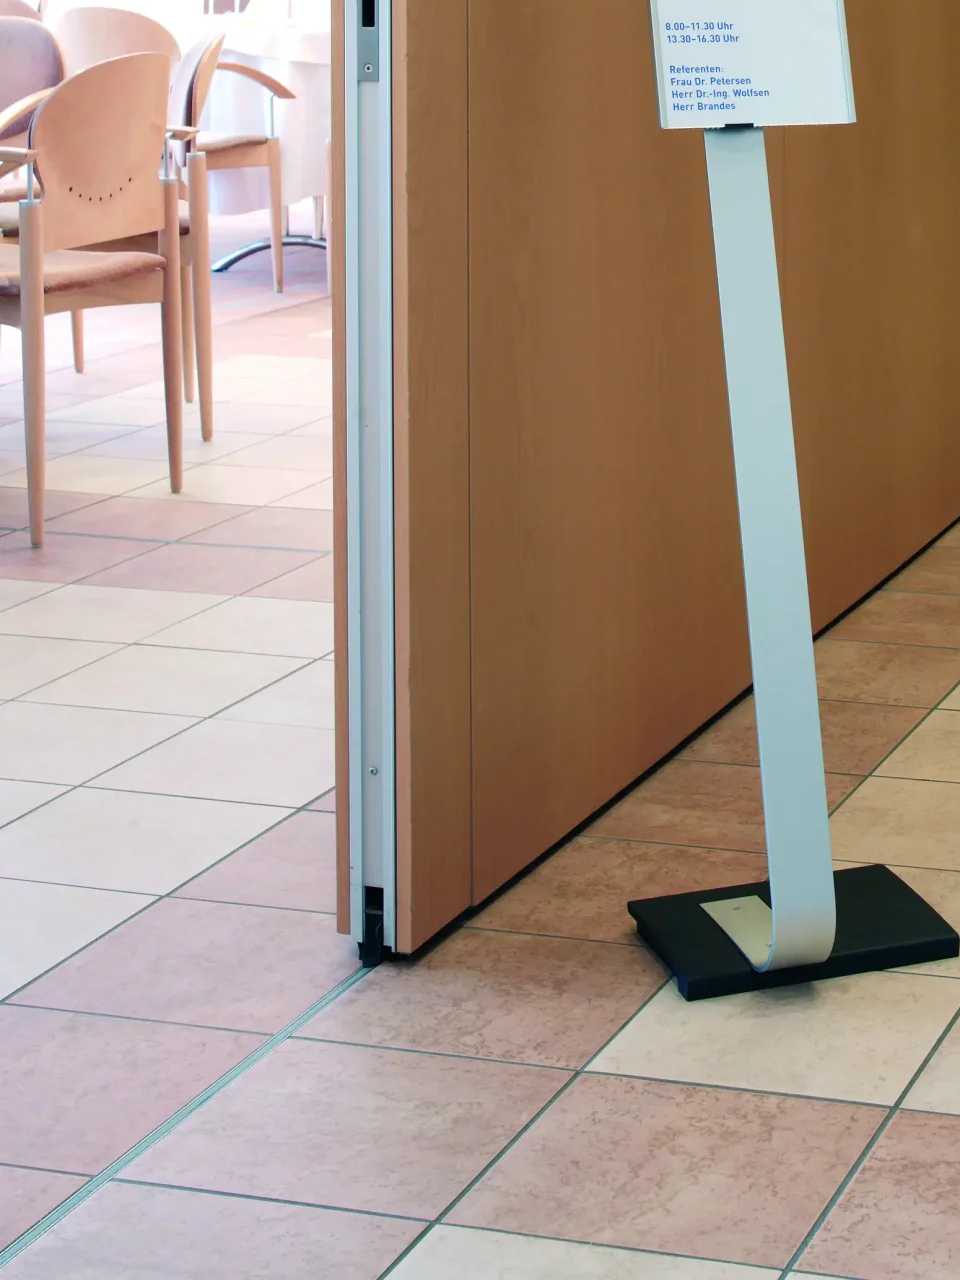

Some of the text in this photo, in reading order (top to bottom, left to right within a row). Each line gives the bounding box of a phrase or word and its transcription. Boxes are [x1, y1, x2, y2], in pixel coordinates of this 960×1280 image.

[717, 22, 734, 30] Uhr
[723, 34, 739, 42] Uhr
[669, 65, 724, 74] Referenten:
[671, 76, 751, 86] Frau Dr. Petersen
[671, 88, 770, 99] Herr Dr.-Ing. Wolfsen
[673, 102, 736, 111] Herr Brandes
